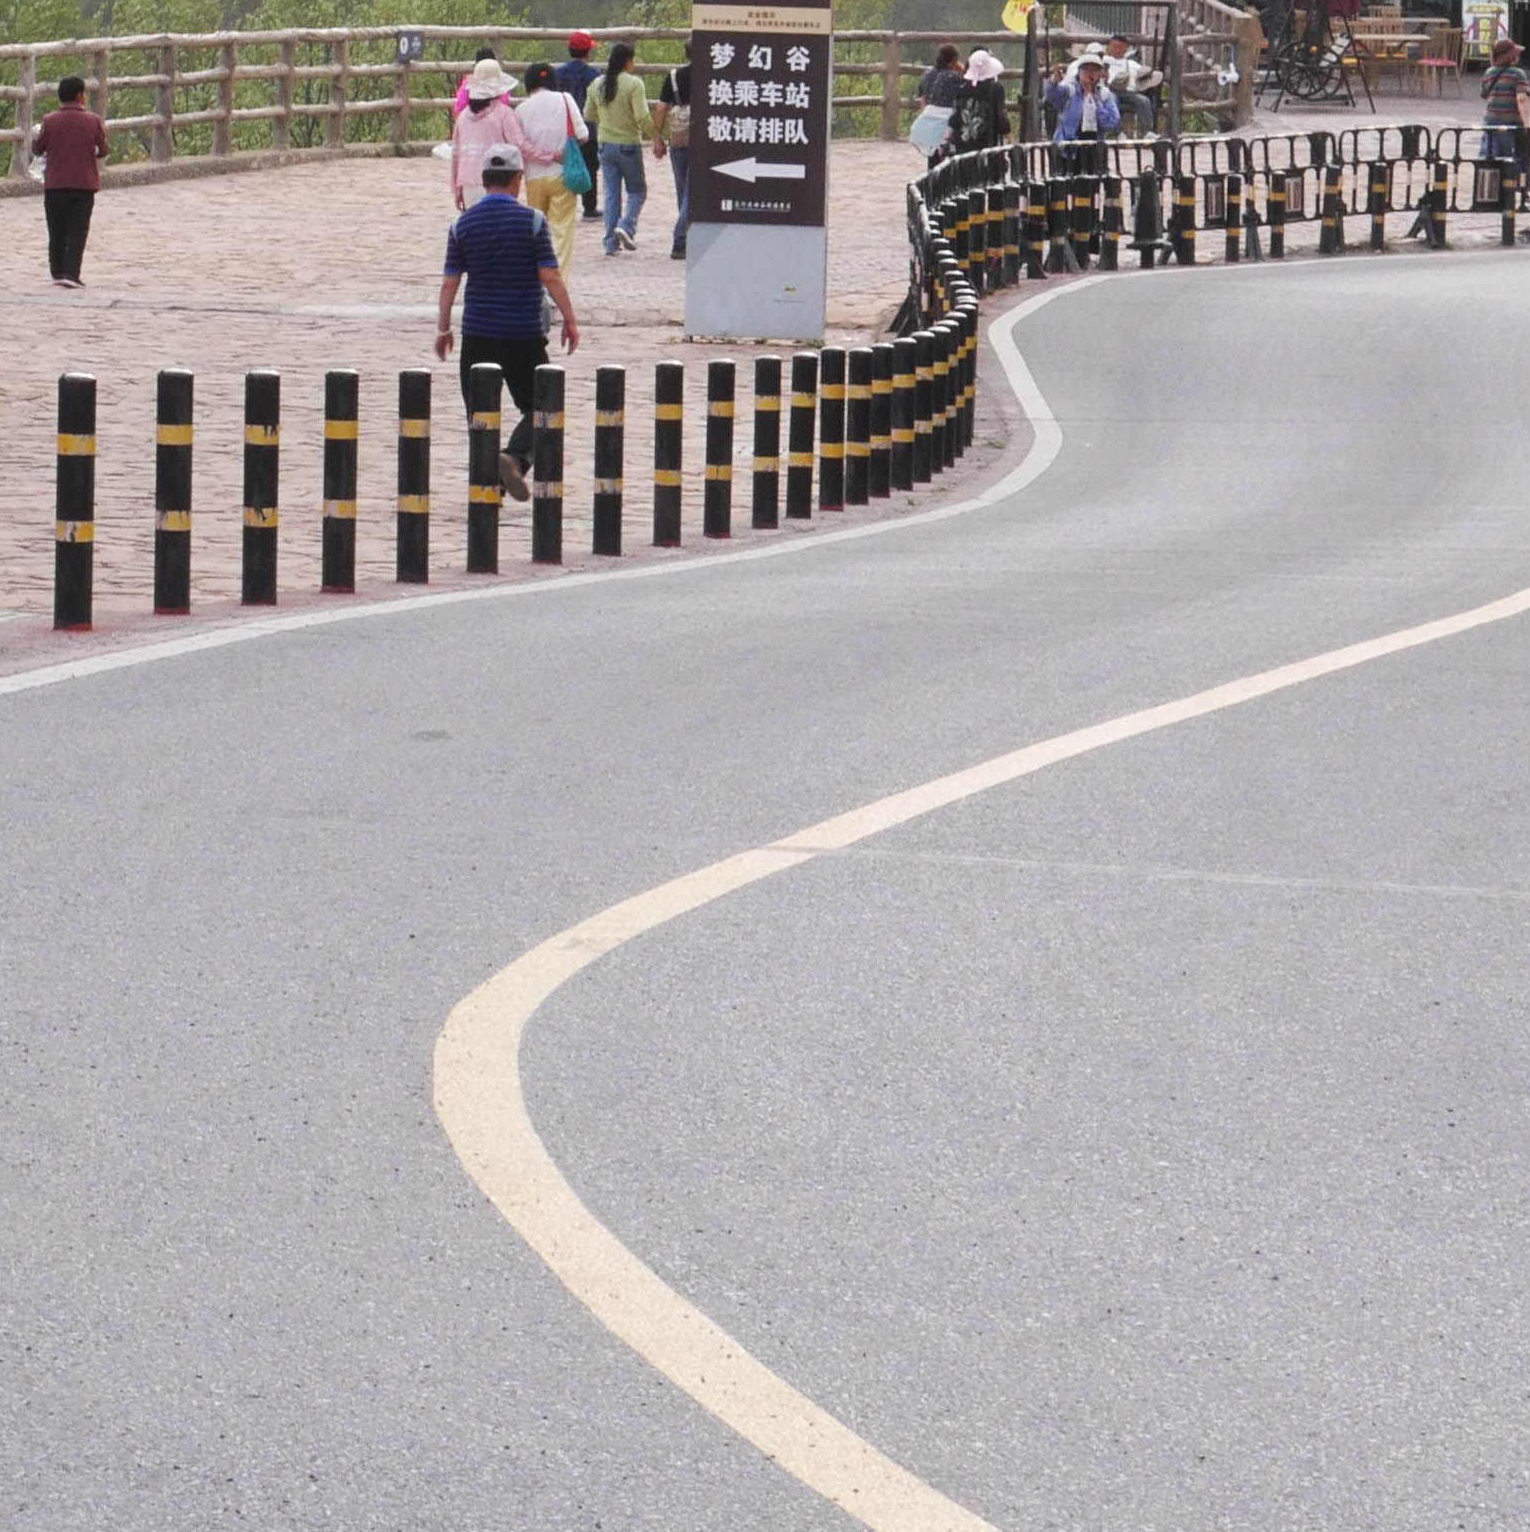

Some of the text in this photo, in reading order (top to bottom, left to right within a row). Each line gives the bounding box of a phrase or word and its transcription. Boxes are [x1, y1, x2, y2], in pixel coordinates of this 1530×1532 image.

[709, 43, 811, 72] 梦幻谷
[708, 80, 810, 109] 换乘车站
[707, 116, 809, 145] 敬请排队
